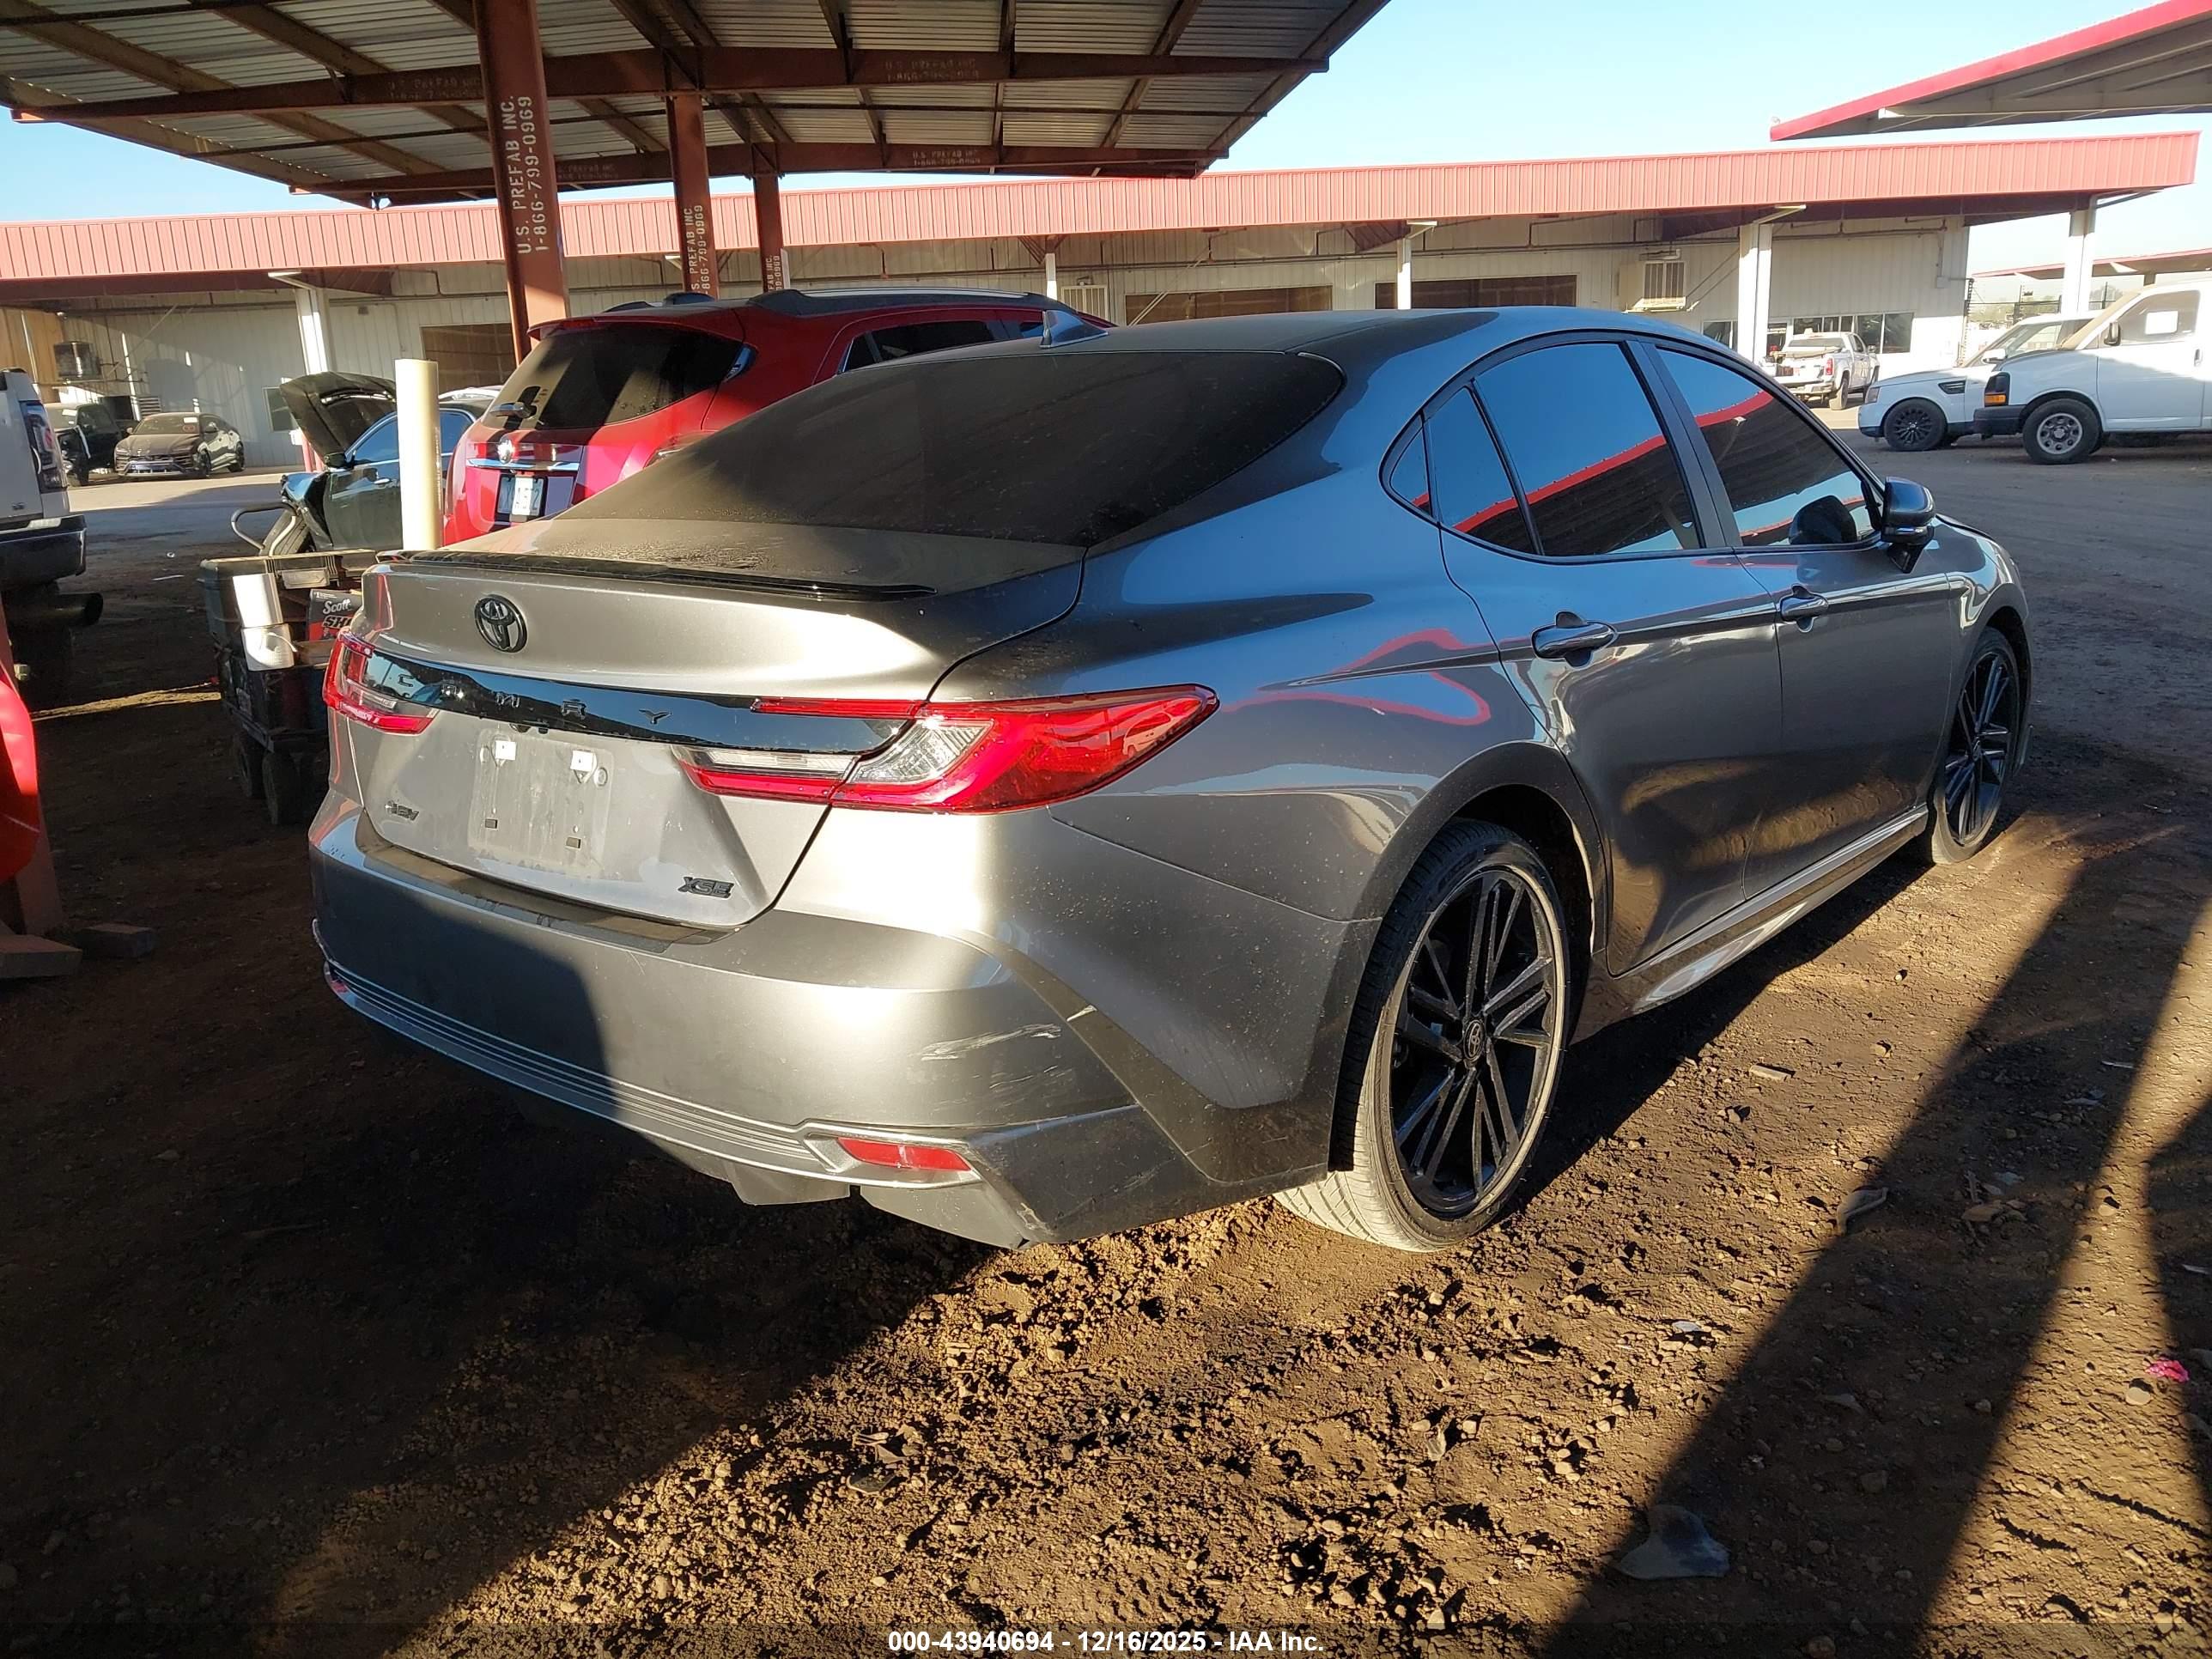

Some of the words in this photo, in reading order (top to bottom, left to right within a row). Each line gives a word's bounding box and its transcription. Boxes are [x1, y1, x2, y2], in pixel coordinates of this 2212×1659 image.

[501, 95, 518, 131] INC.
[505, 140, 527, 210] PREFAB
[517, 96, 550, 252] 1-866-799-0969
[515, 220, 532, 254] U.S.
[686, 231, 699, 275] PREFAB
[694, 204, 711, 295] -866-799-0969
[322, 599, 351, 615] Scott
[397, 673, 673, 725] CAMRY
[678, 876, 735, 899] XSE
